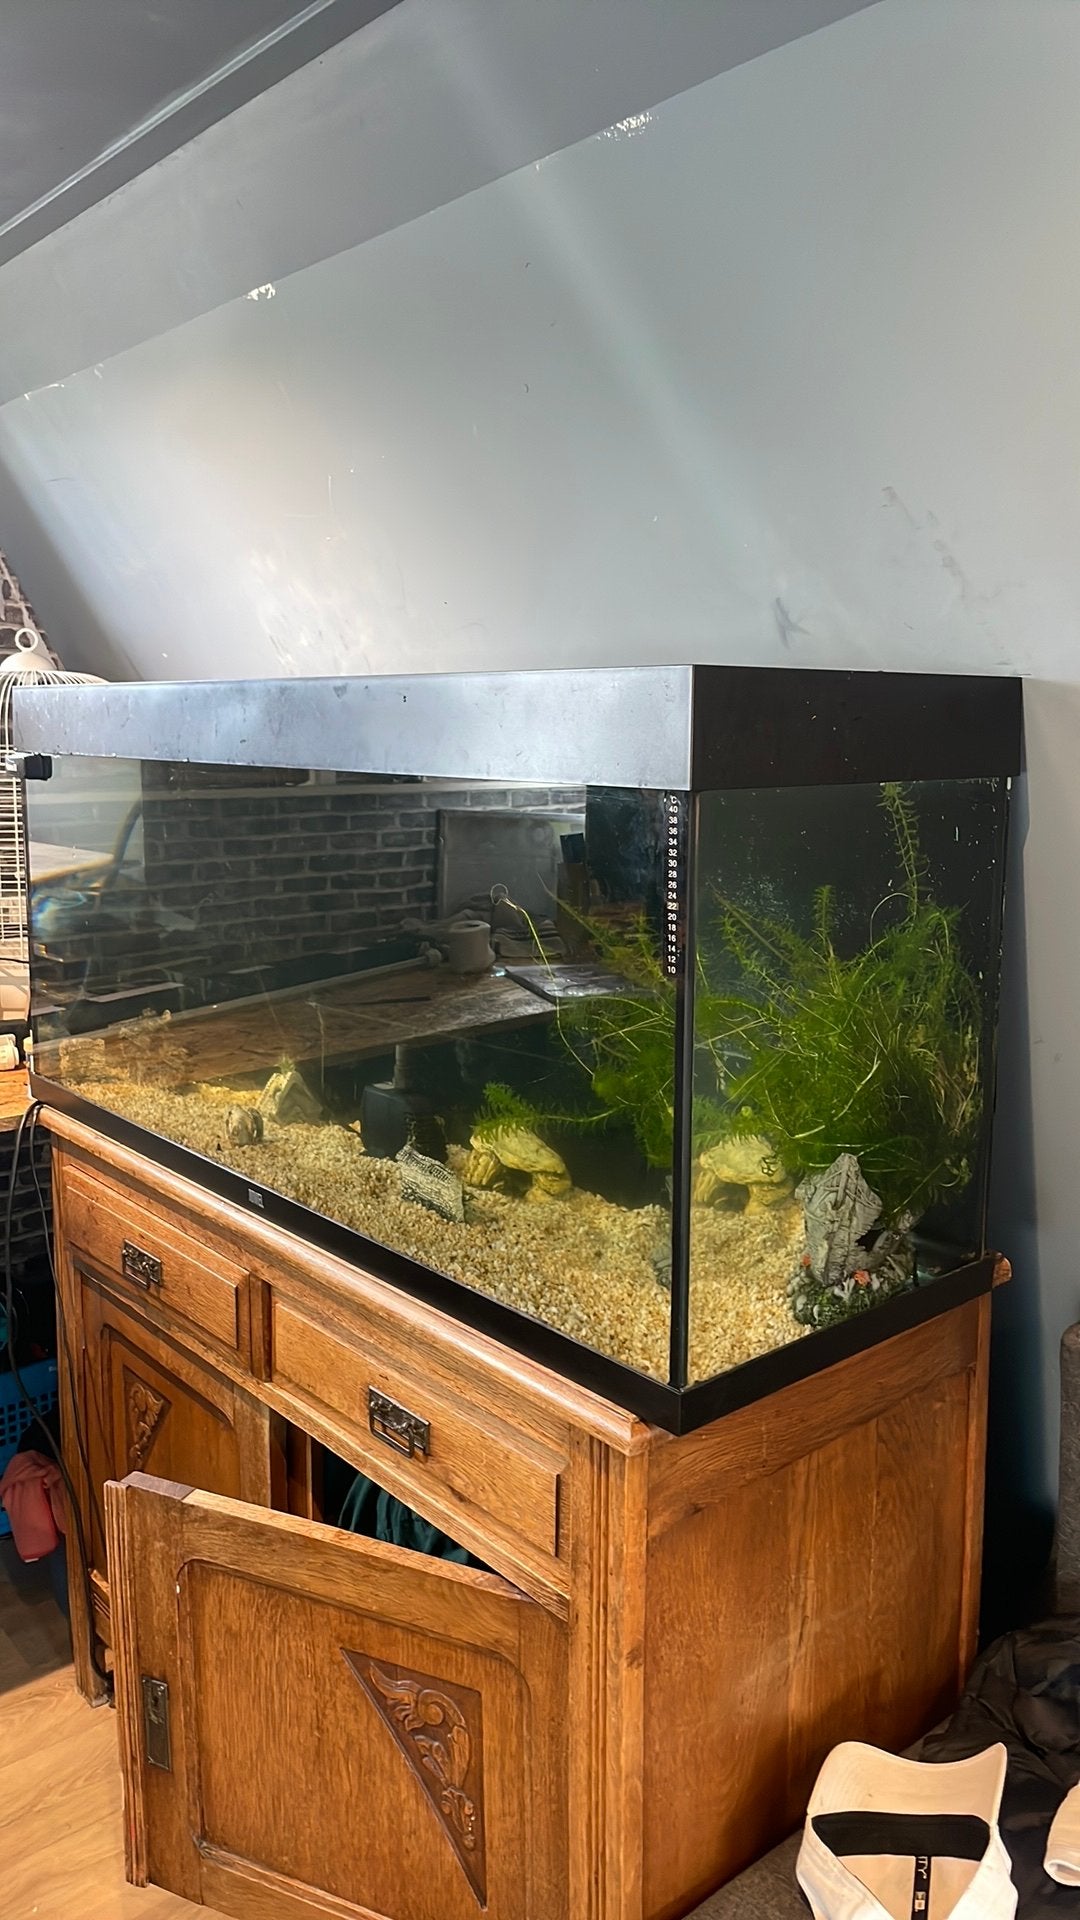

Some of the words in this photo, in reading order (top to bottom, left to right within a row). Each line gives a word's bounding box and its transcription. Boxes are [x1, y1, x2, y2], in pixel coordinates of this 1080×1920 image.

[668, 827, 678, 835] 36
[668, 848, 677, 856] 32
[668, 870, 677, 878] 28
[667, 902, 677, 910] 22
